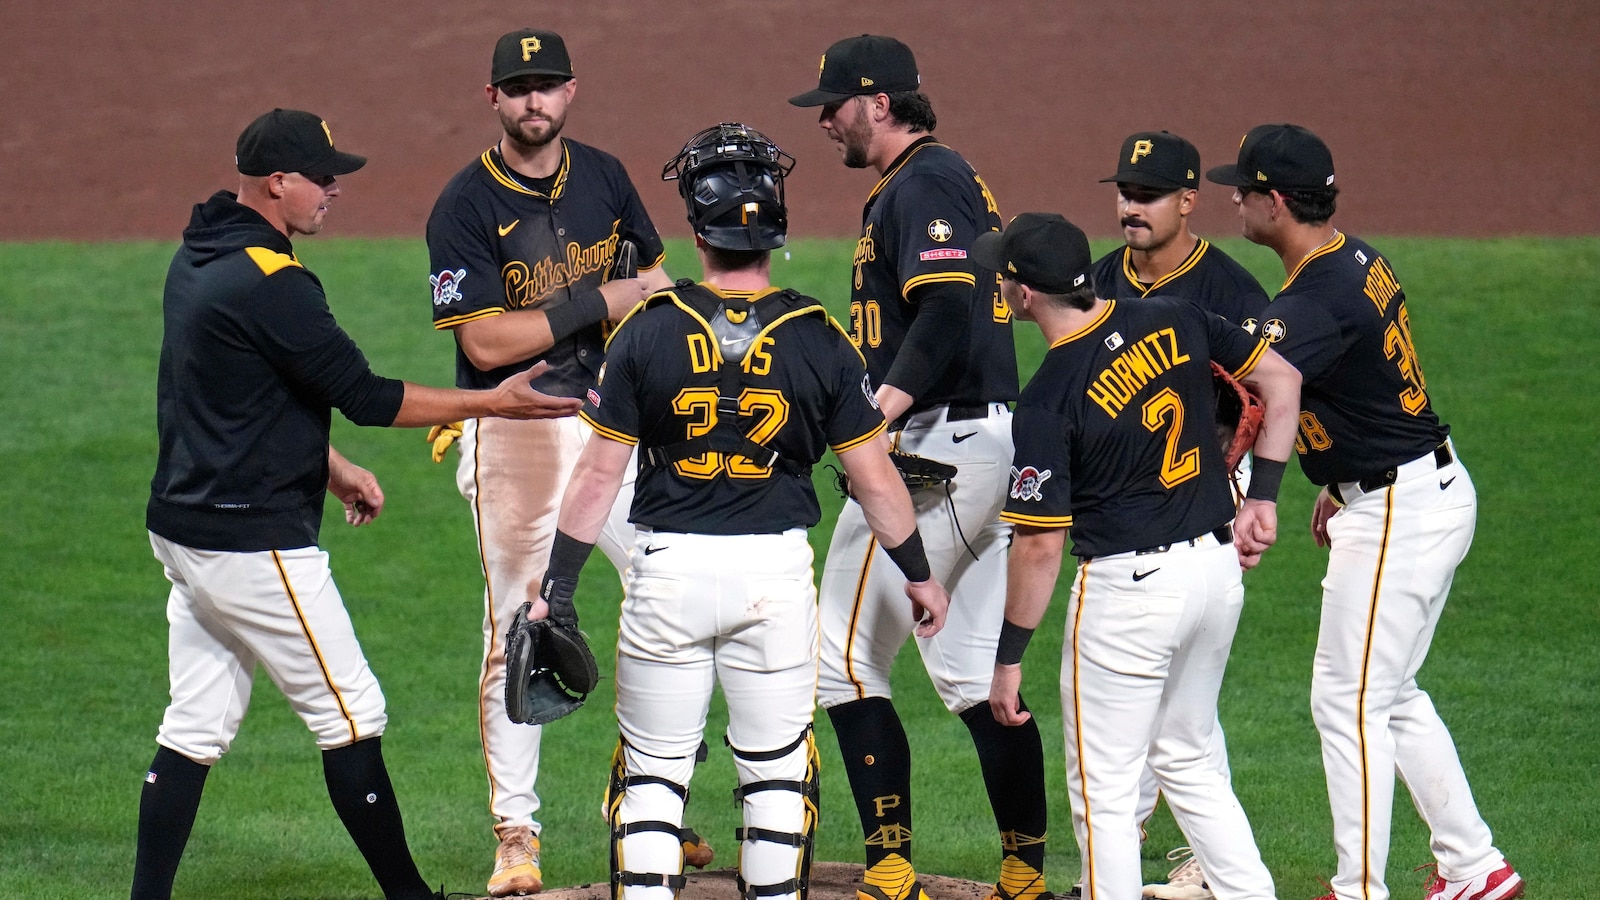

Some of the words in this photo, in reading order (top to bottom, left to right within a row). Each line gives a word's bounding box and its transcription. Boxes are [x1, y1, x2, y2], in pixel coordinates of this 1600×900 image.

[520, 36, 541, 62] P
[1130, 139, 1154, 165] P
[922, 249, 965, 259] SHEETZ
[850, 300, 882, 349] 30
[1086, 327, 1191, 420] HORWITZ
[671, 386, 790, 480] 32
[1141, 386, 1201, 490] 2
[873, 793, 901, 817] P
